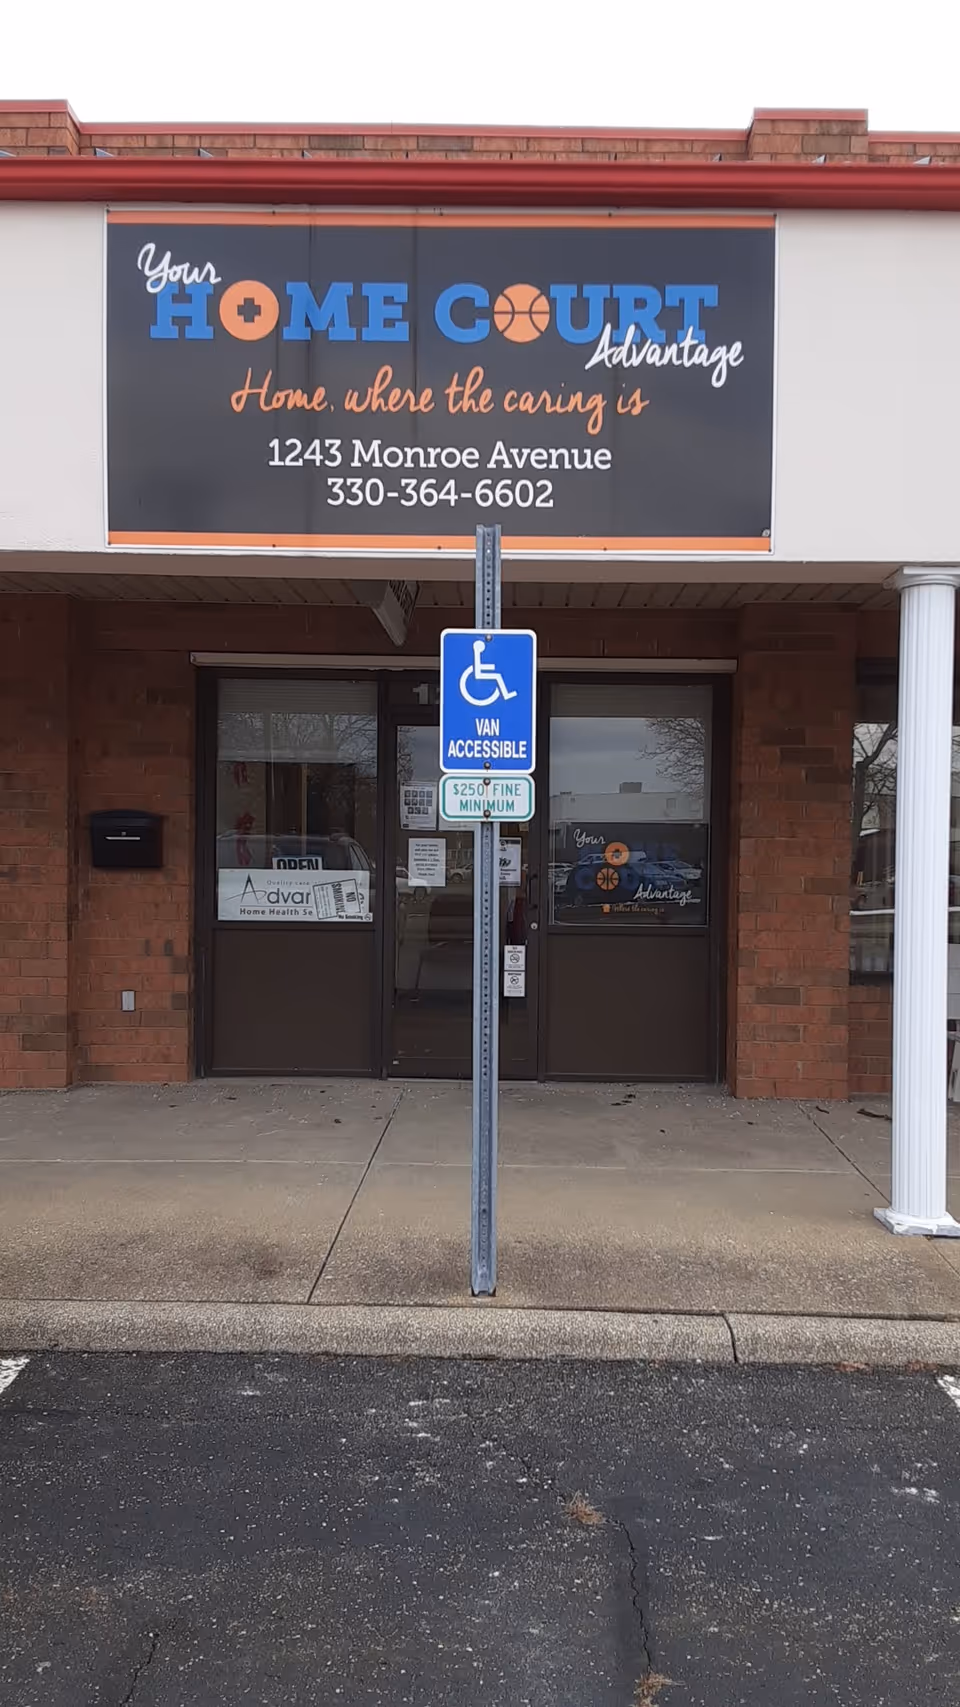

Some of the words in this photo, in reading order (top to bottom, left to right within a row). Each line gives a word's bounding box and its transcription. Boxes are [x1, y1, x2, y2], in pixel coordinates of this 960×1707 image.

[137, 242, 221, 294] Your
[150, 279, 410, 342] HOME
[434, 283, 719, 344] COURT
[585, 323, 744, 388] Advantage
[230, 367, 335, 414] Home,
[344, 364, 435, 414] where
[445, 365, 494, 415] the
[503, 382, 608, 436] caring
[616, 382, 650, 416] is
[268, 438, 342, 468] 1243
[350, 439, 480, 468] Monroe
[486, 441, 612, 470] Avenue
[326, 477, 554, 508] 330-364-6602
[475, 718, 500, 737] VAN
[447, 739, 528, 759] ACCESSIBLE
[453, 783, 485, 797] $250
[492, 783, 522, 797] FINE
[459, 799, 515, 813] MINIMUM
[573, 829, 606, 848] Your
[633, 884, 693, 907] Advantage
[239, 907, 266, 916] Home
[269, 907, 300, 916] Health
